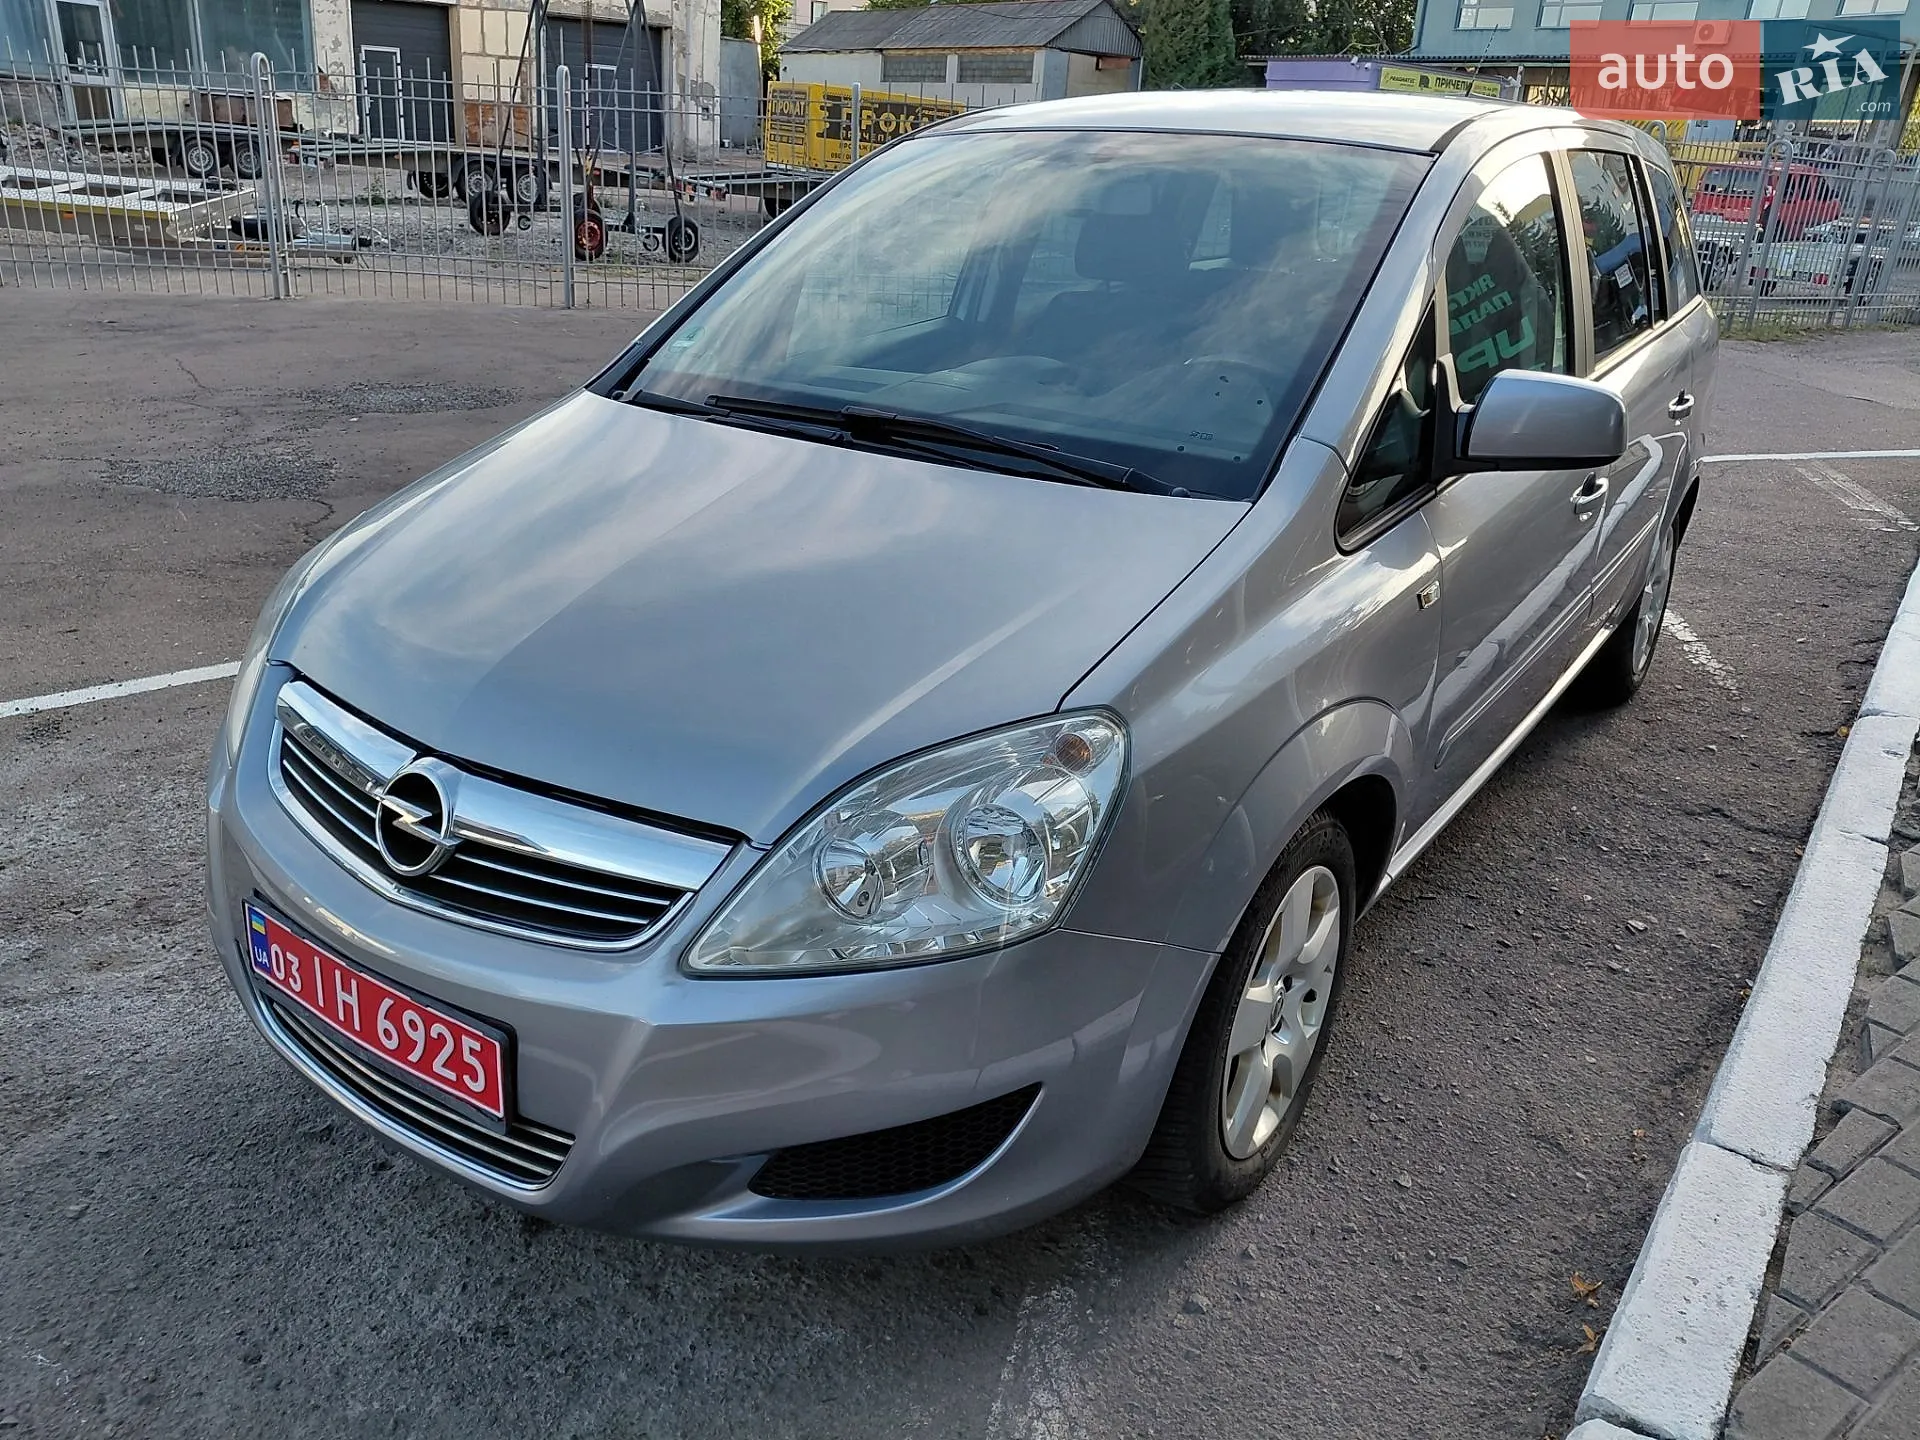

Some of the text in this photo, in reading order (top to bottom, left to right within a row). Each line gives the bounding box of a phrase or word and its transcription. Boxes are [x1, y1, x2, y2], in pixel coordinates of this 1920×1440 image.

[254, 946, 270, 969] UA
[270, 943, 302, 993] 03
[376, 998, 486, 1093] 6925
